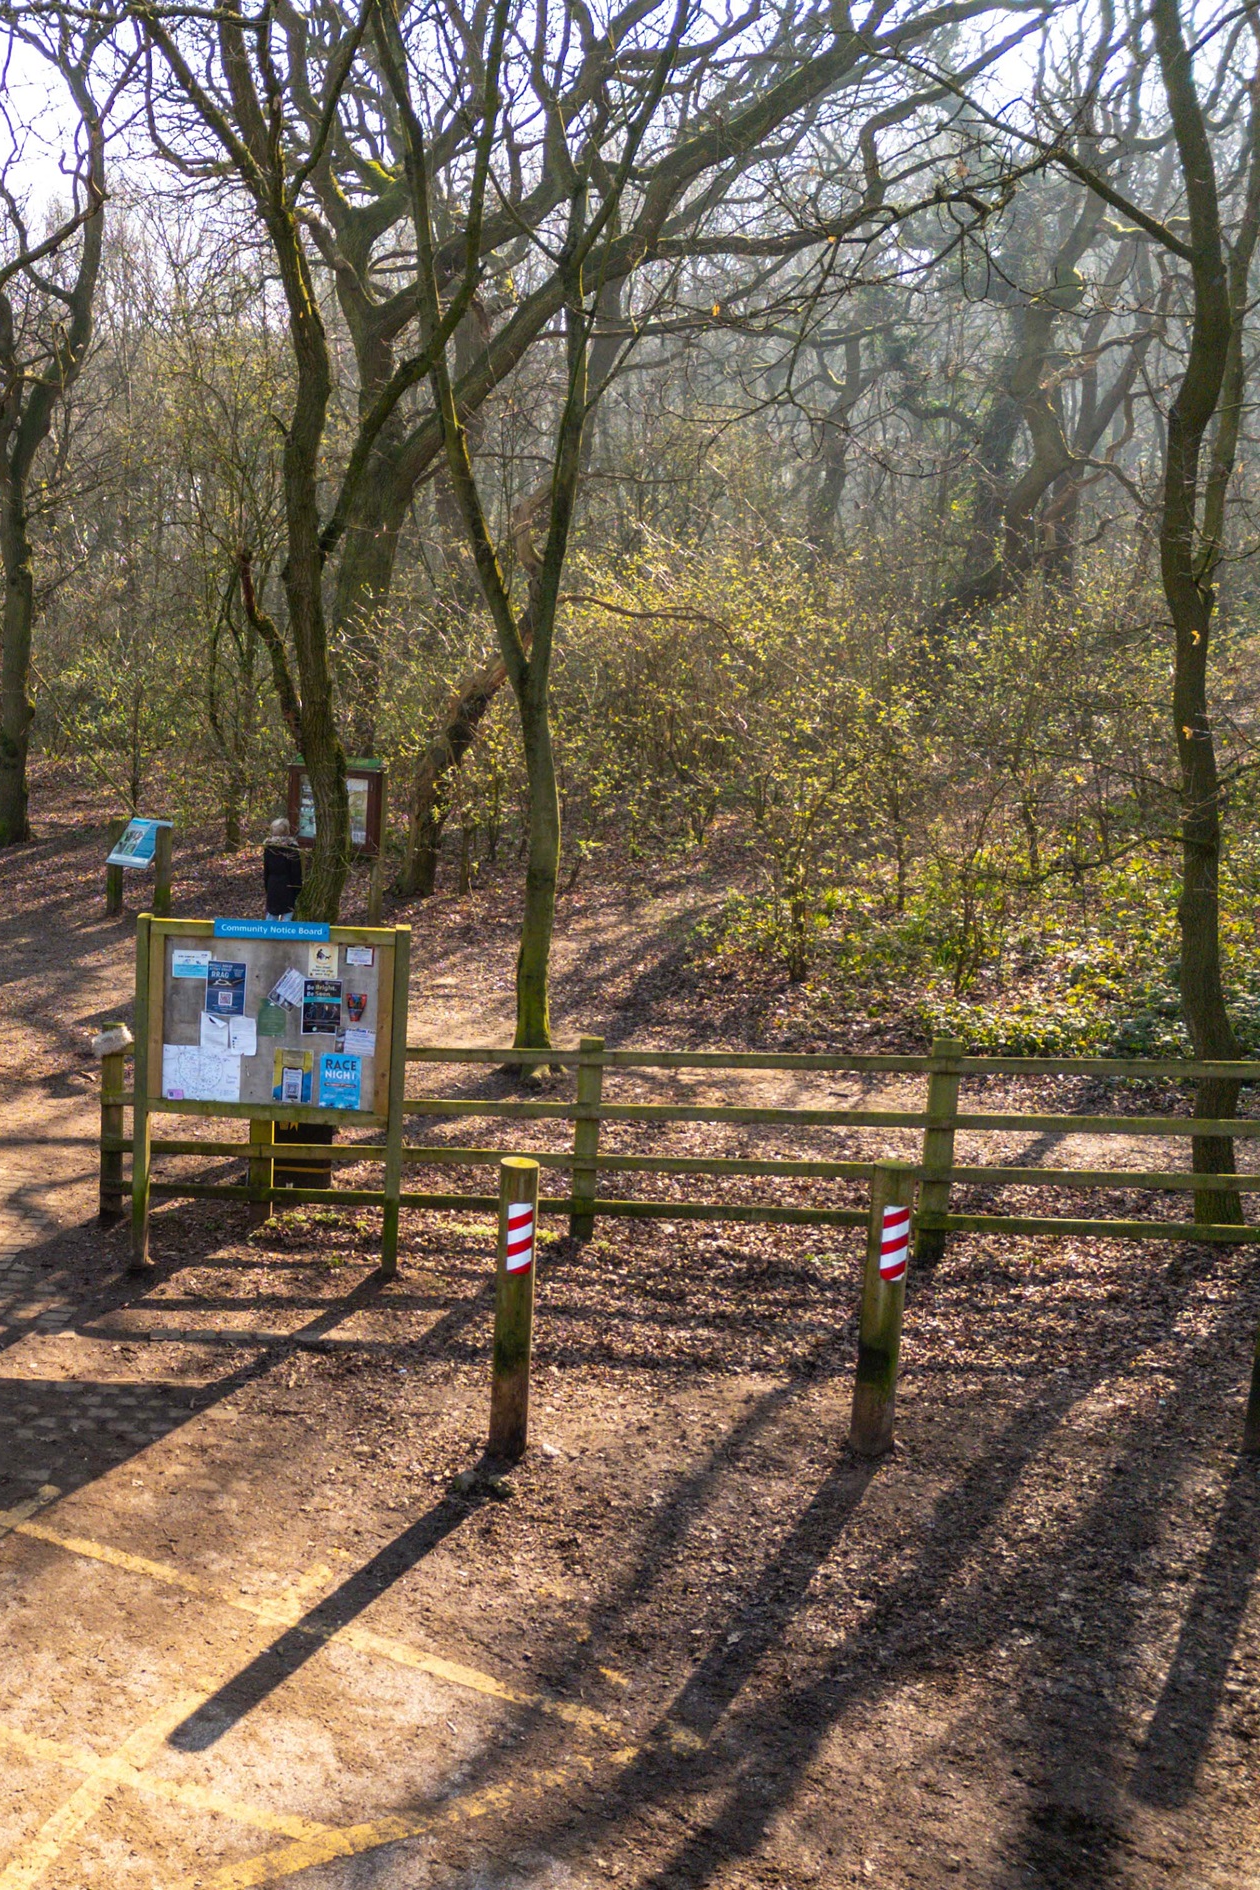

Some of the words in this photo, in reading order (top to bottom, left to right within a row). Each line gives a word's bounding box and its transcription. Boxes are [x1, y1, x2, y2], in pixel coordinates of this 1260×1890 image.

[221, 923, 268, 934] Community
[270, 926, 296, 934] Notice
[298, 927, 323, 935] Board
[325, 1059, 357, 1071] RACE
[325, 1070, 356, 1080] NIGHT
